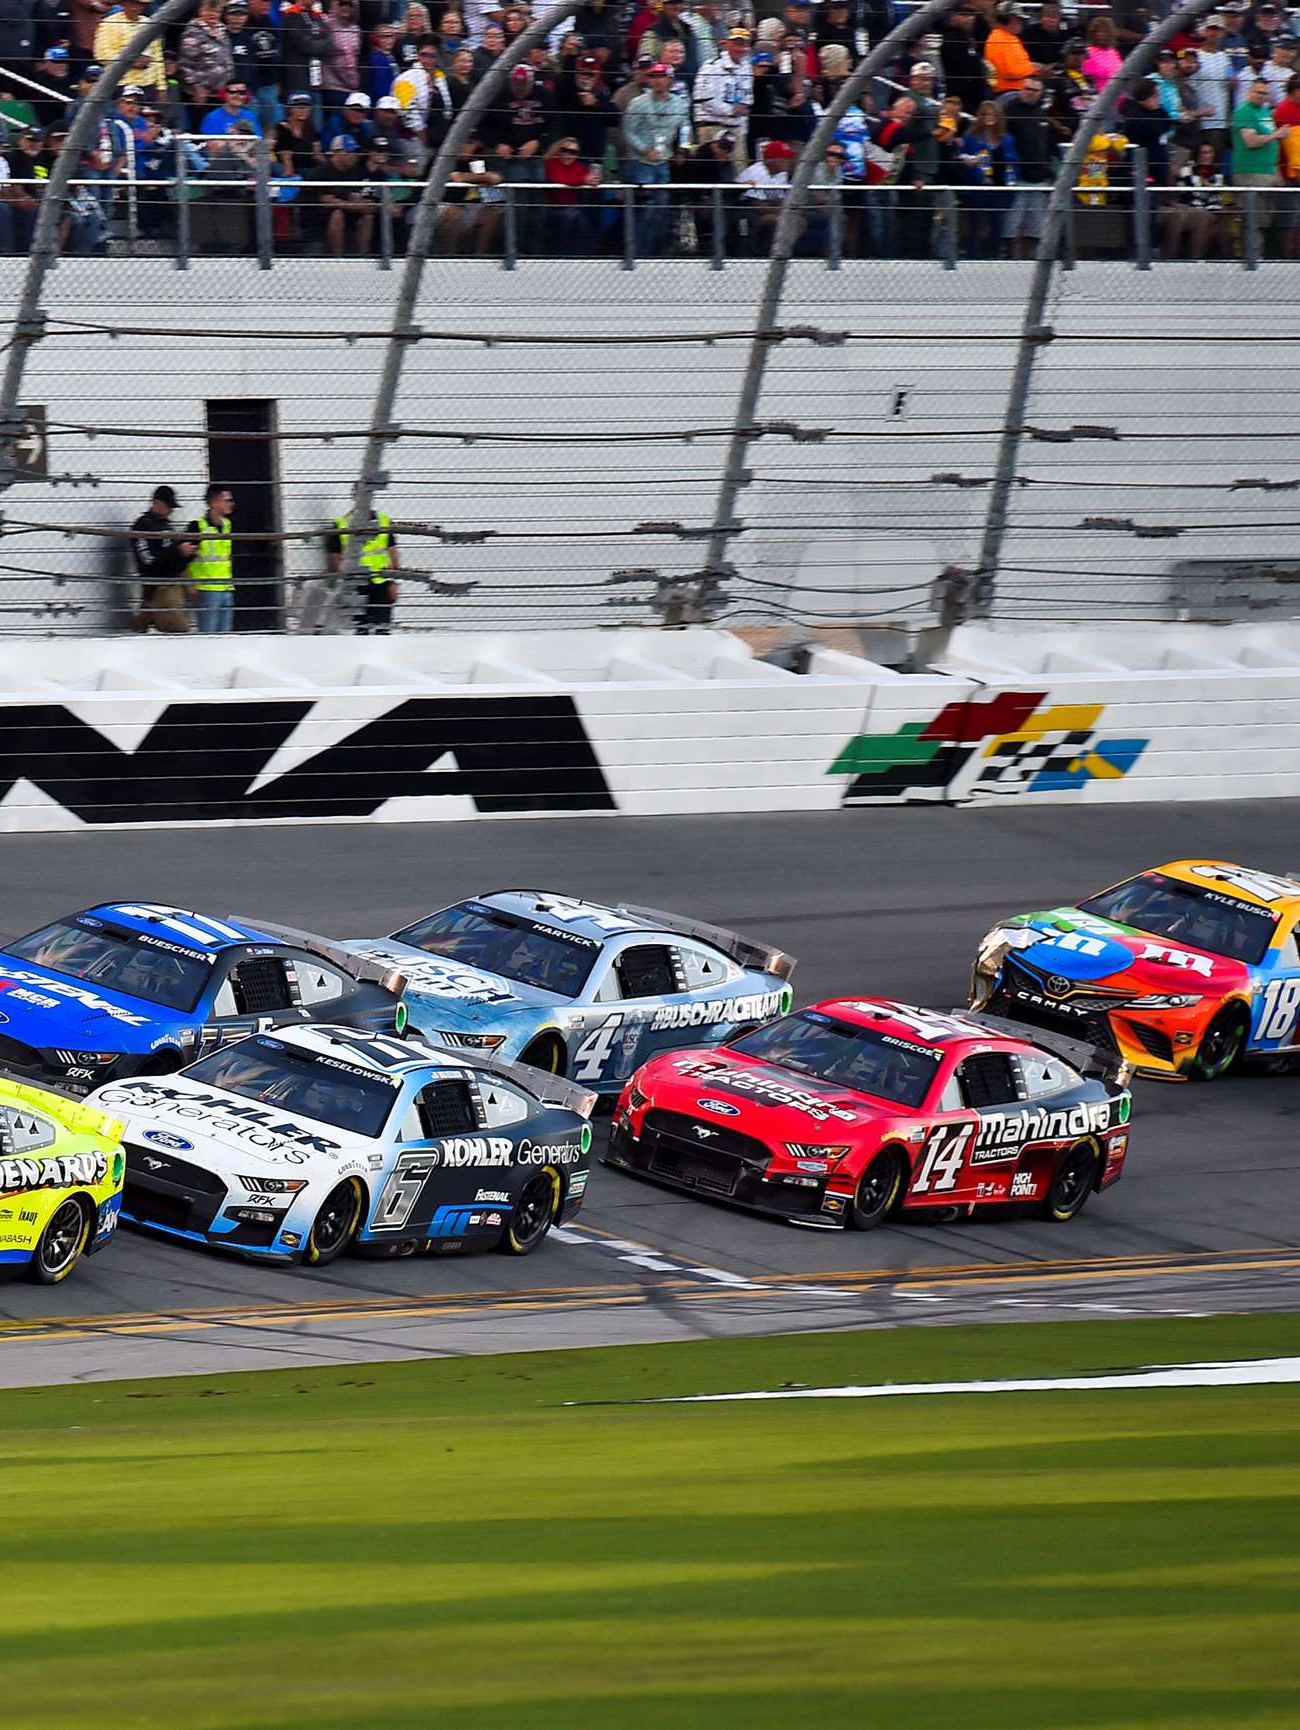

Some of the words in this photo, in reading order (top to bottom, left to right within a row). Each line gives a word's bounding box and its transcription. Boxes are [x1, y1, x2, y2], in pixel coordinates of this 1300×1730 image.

[1204, 892, 1235, 907] KYLE
[137, 935, 207, 961] BUESCHER
[532, 924, 593, 948] HARVICK
[651, 994, 780, 1031] #BUSCHRACETEAM
[1016, 991, 1089, 1017] CAMRY
[1254, 977, 1300, 1041] 18
[574, 1013, 624, 1080] 4
[881, 1036, 934, 1057] BRISCOE
[119, 1082, 341, 1155] KOHLER
[701, 1099, 737, 1115] Ford
[99, 1089, 310, 1165] Generators
[976, 1102, 1111, 1147] mahindra
[147, 1130, 190, 1150] Ford
[440, 1138, 510, 1167] KOHLER
[517, 1139, 580, 1165] Generators
[974, 1145, 1019, 1160] TRACTORS
[912, 1124, 975, 1193] 14
[369, 1148, 439, 1232] 6
[1013, 1173, 1033, 1183] HIGH
